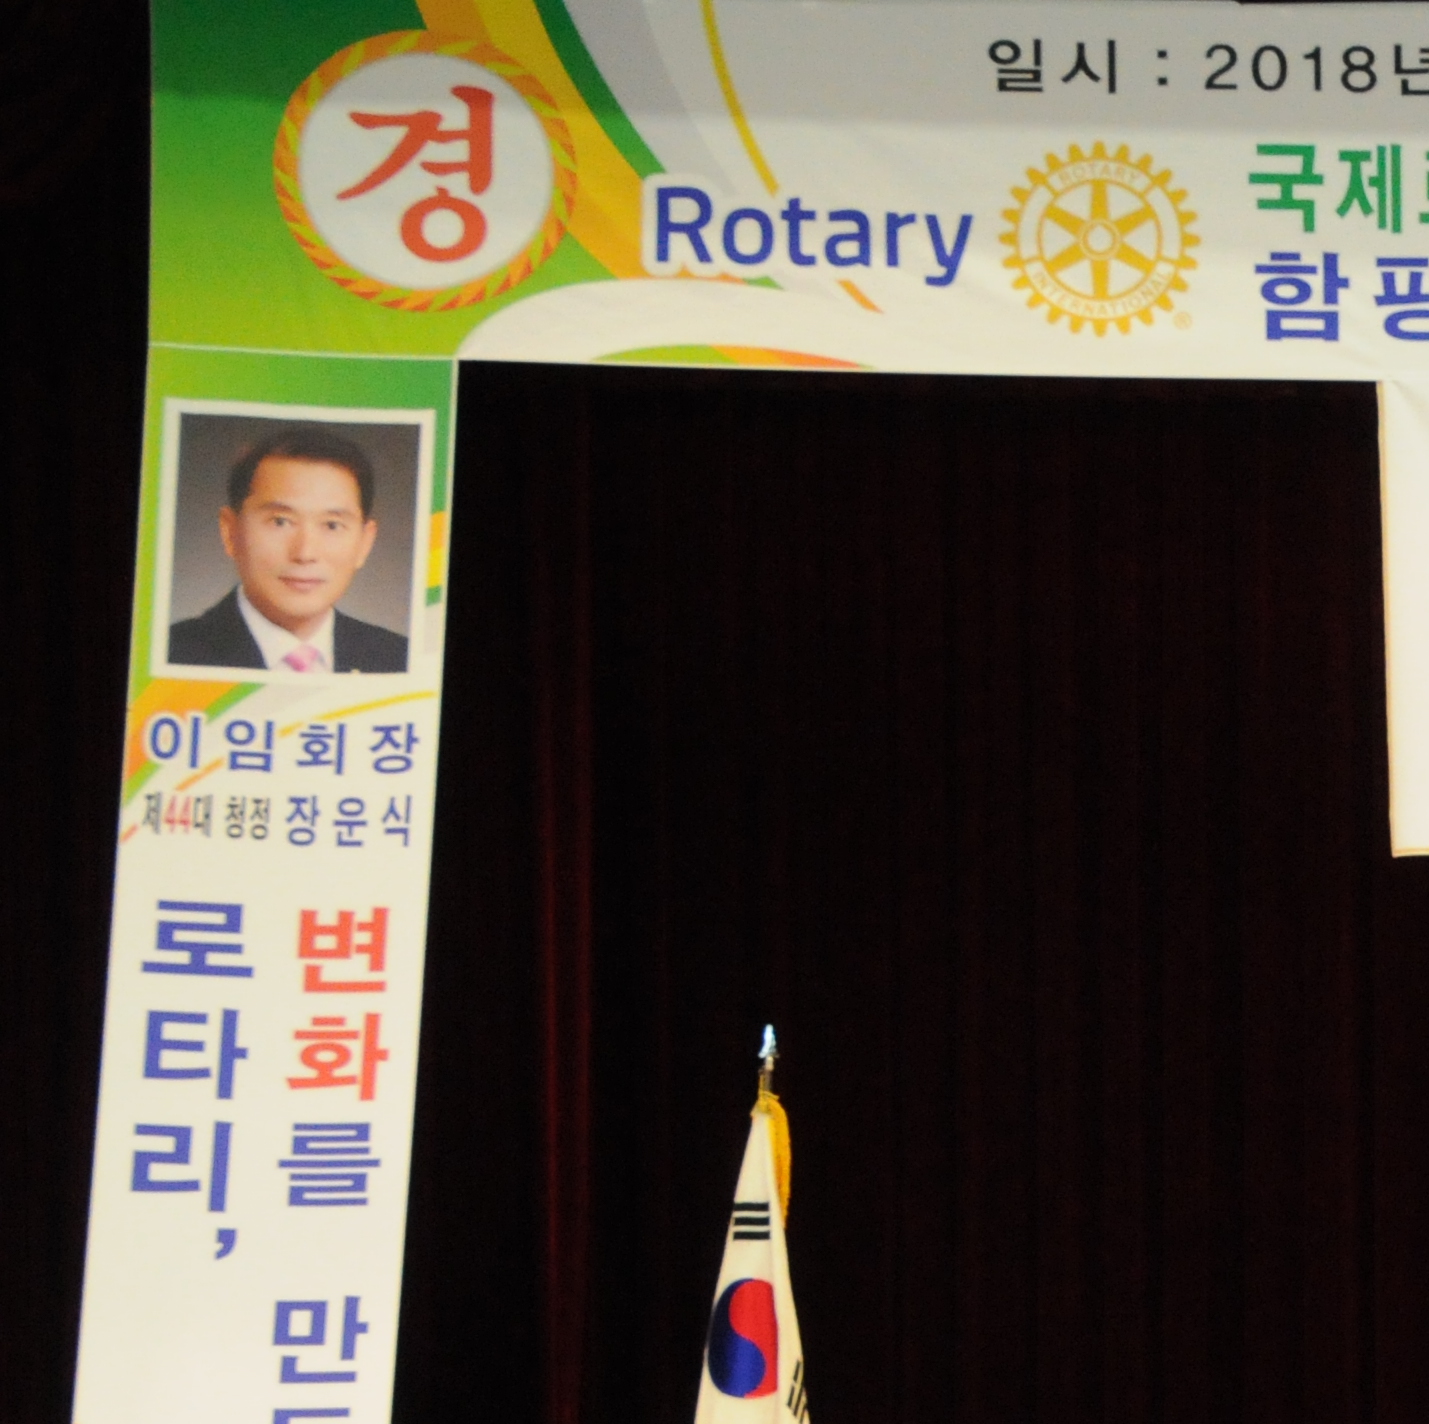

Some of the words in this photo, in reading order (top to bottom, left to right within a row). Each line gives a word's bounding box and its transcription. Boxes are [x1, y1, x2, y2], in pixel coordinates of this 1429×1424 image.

[987, 38, 1117, 93] 일시
[334, 83, 497, 263] 경
[653, 185, 974, 286] Rotary
[225, 795, 271, 841] 청정
[285, 795, 413, 848] 장운식
[276, 905, 391, 1208] 변화를
